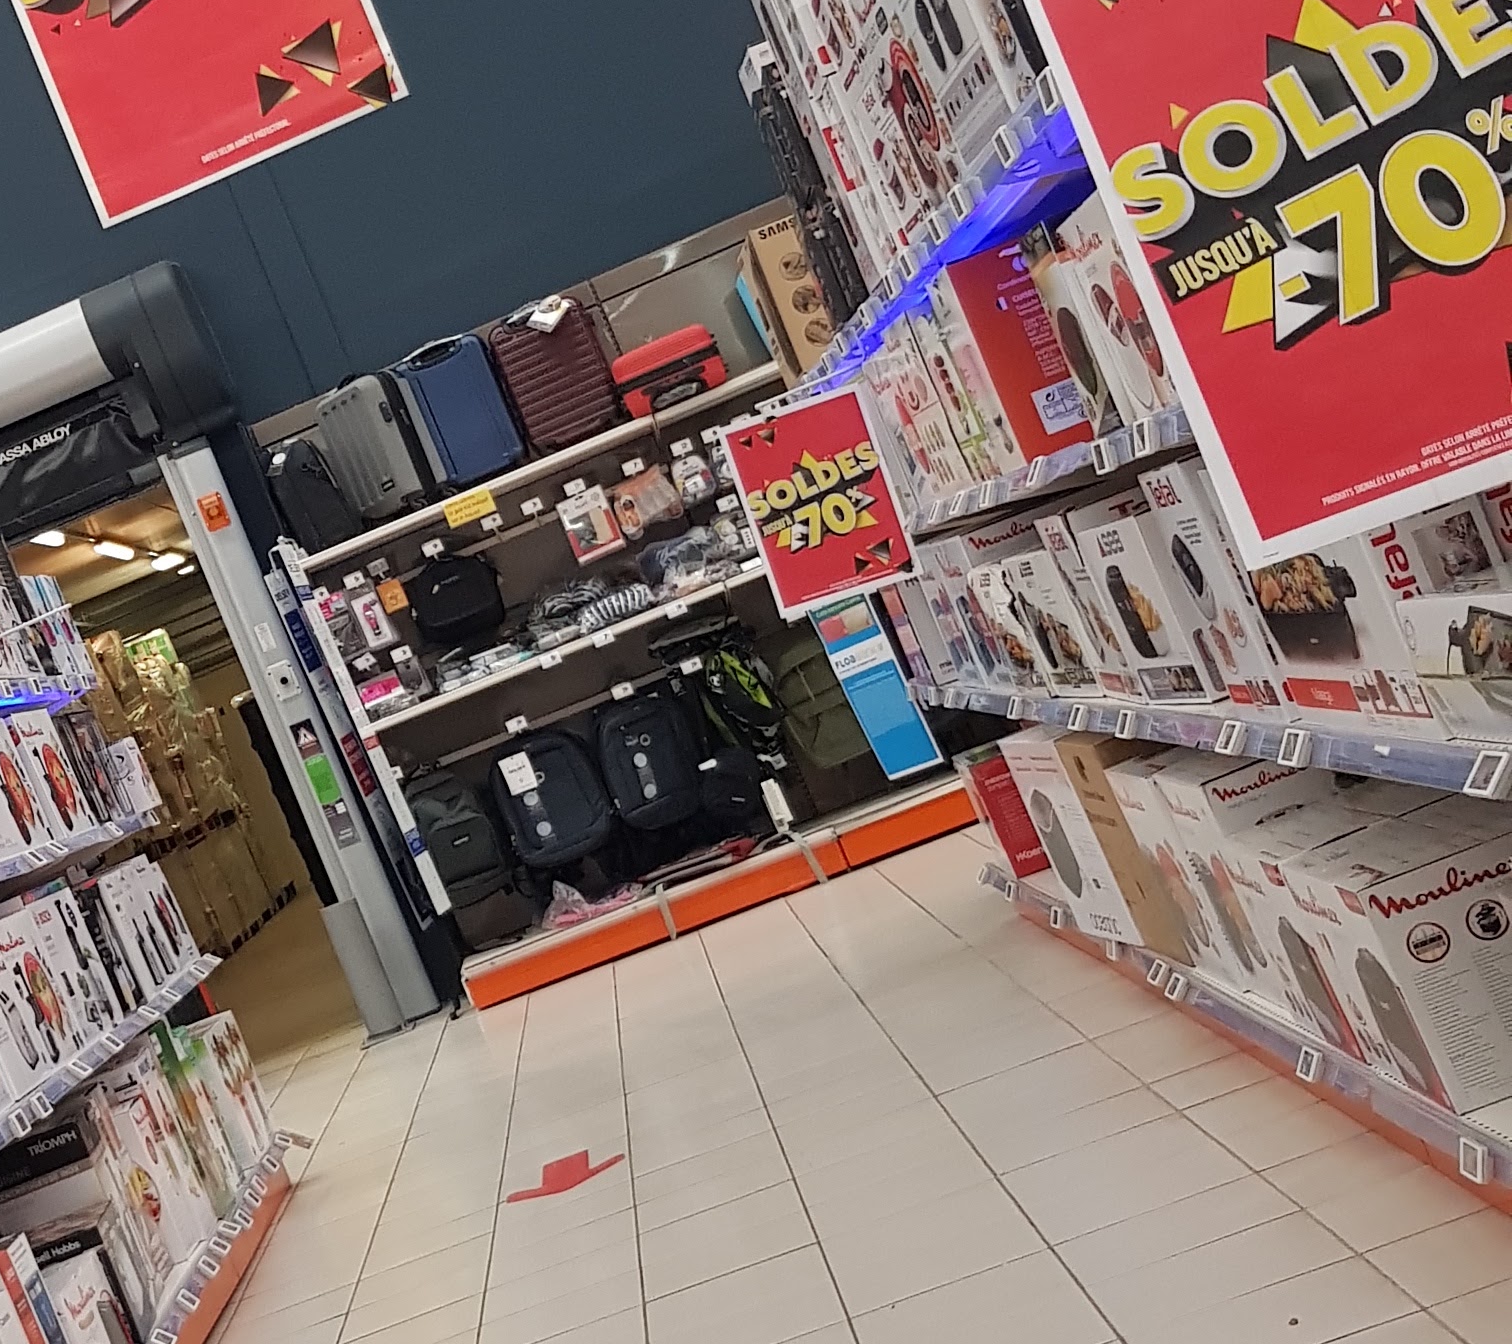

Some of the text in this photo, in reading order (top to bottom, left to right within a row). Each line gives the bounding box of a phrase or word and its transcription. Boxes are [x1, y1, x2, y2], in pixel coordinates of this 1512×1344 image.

[1168, 216, 1277, 300] JUSQU'À
[0, 423, 72, 466] ASSA ABLOY
[746, 440, 880, 520] SOLDES
[1146, 475, 1183, 509] Tefal
[967, 520, 1037, 552] Moulin
[1211, 765, 1301, 803] Mouline
[1368, 858, 1512, 920] Mouline
[26, 1130, 78, 1157] TRIOMPH
[51, 1239, 82, 1258] Hobbs
